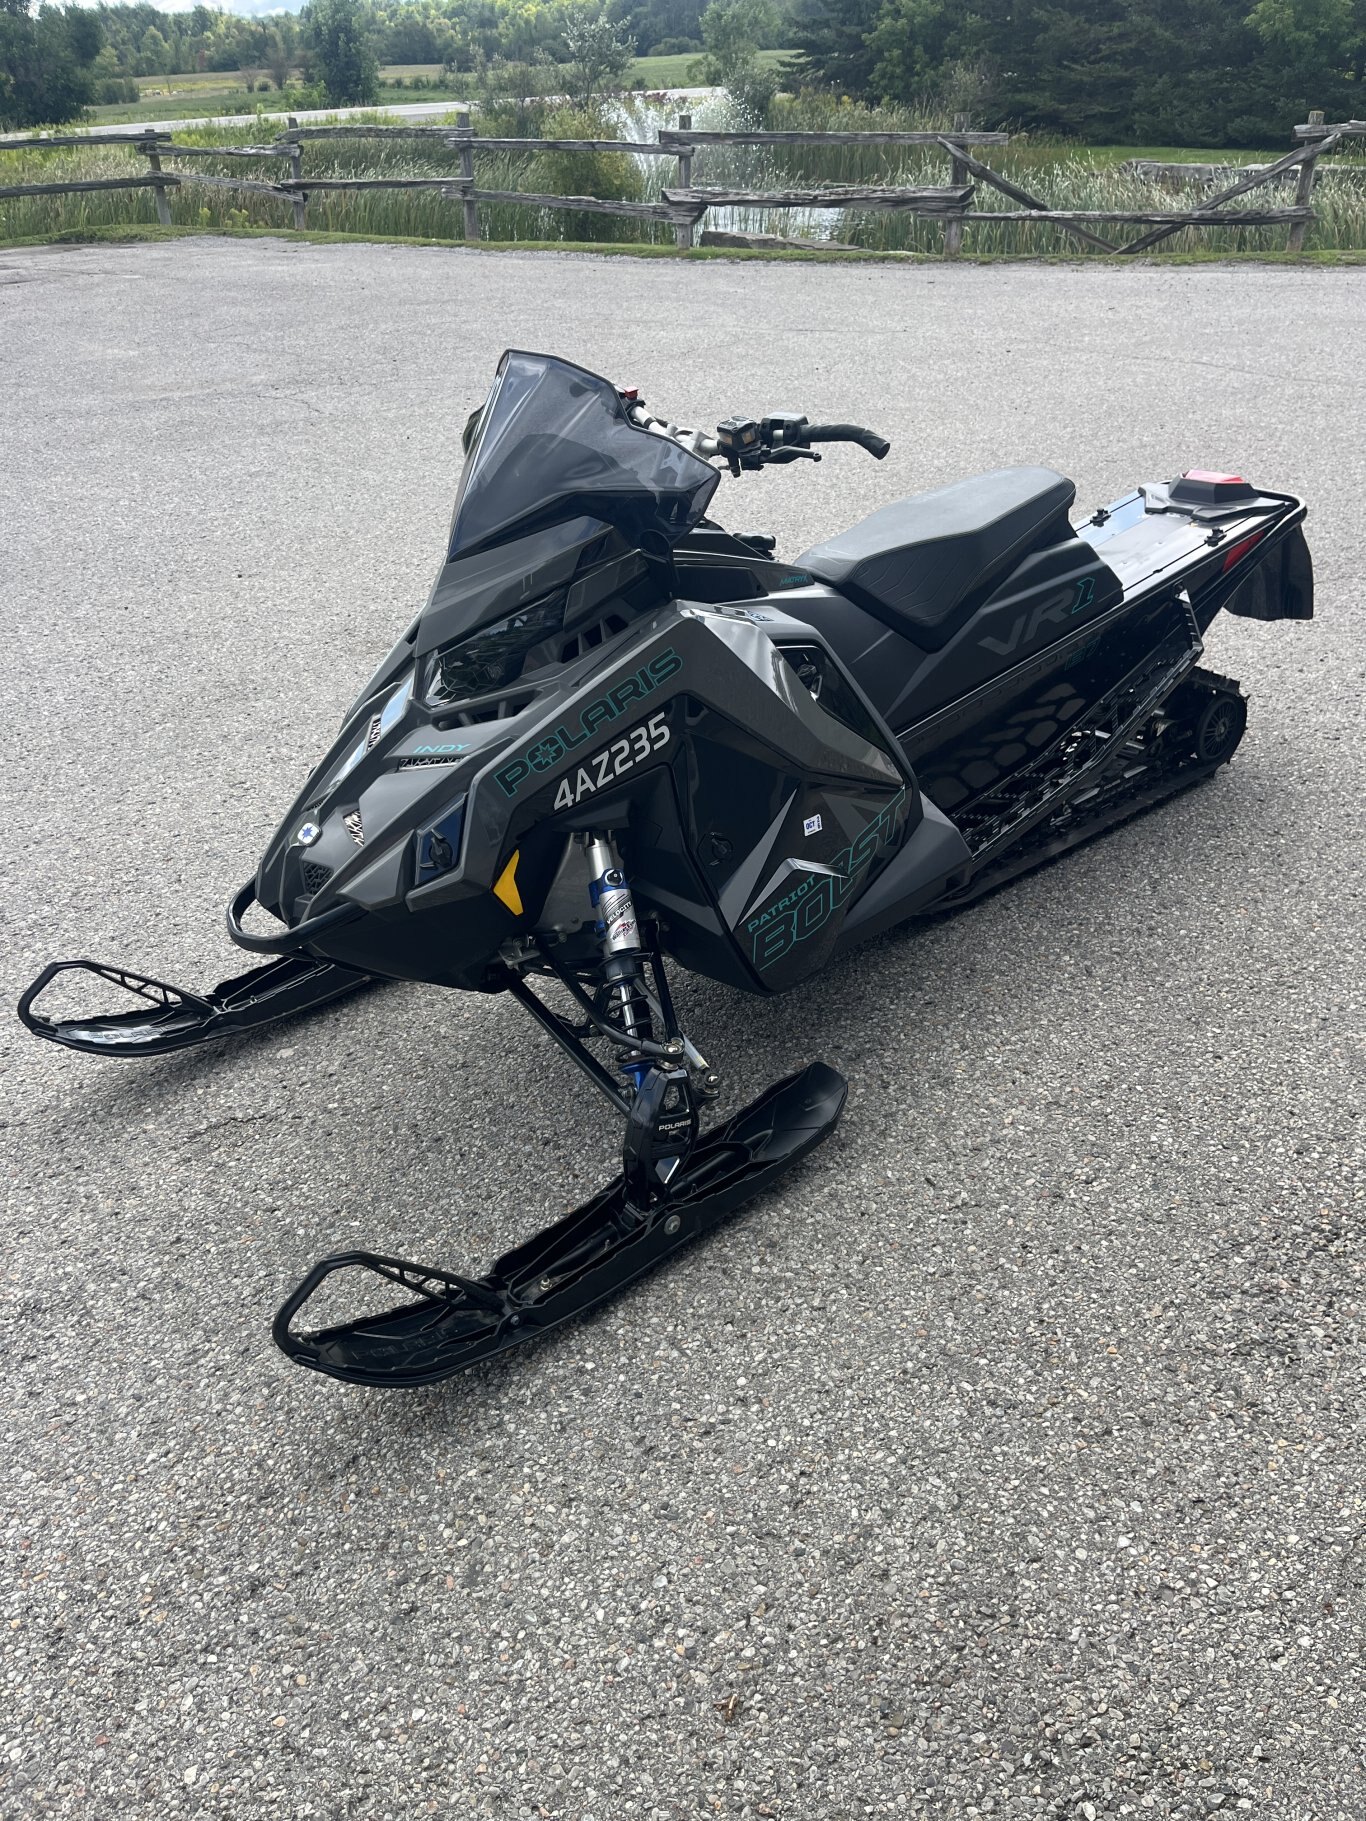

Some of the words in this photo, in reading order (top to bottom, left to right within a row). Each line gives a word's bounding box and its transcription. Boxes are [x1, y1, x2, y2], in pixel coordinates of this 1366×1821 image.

[977, 577, 1096, 656] VR1
[412, 743, 472, 754] INDY
[493, 647, 683, 798] POLARIS
[553, 711, 671, 811] 4AZ235
[606, 900, 632, 924] VELOCITY
[747, 874, 816, 933] PATRIOT
[658, 1118, 692, 1131] POLARIS
